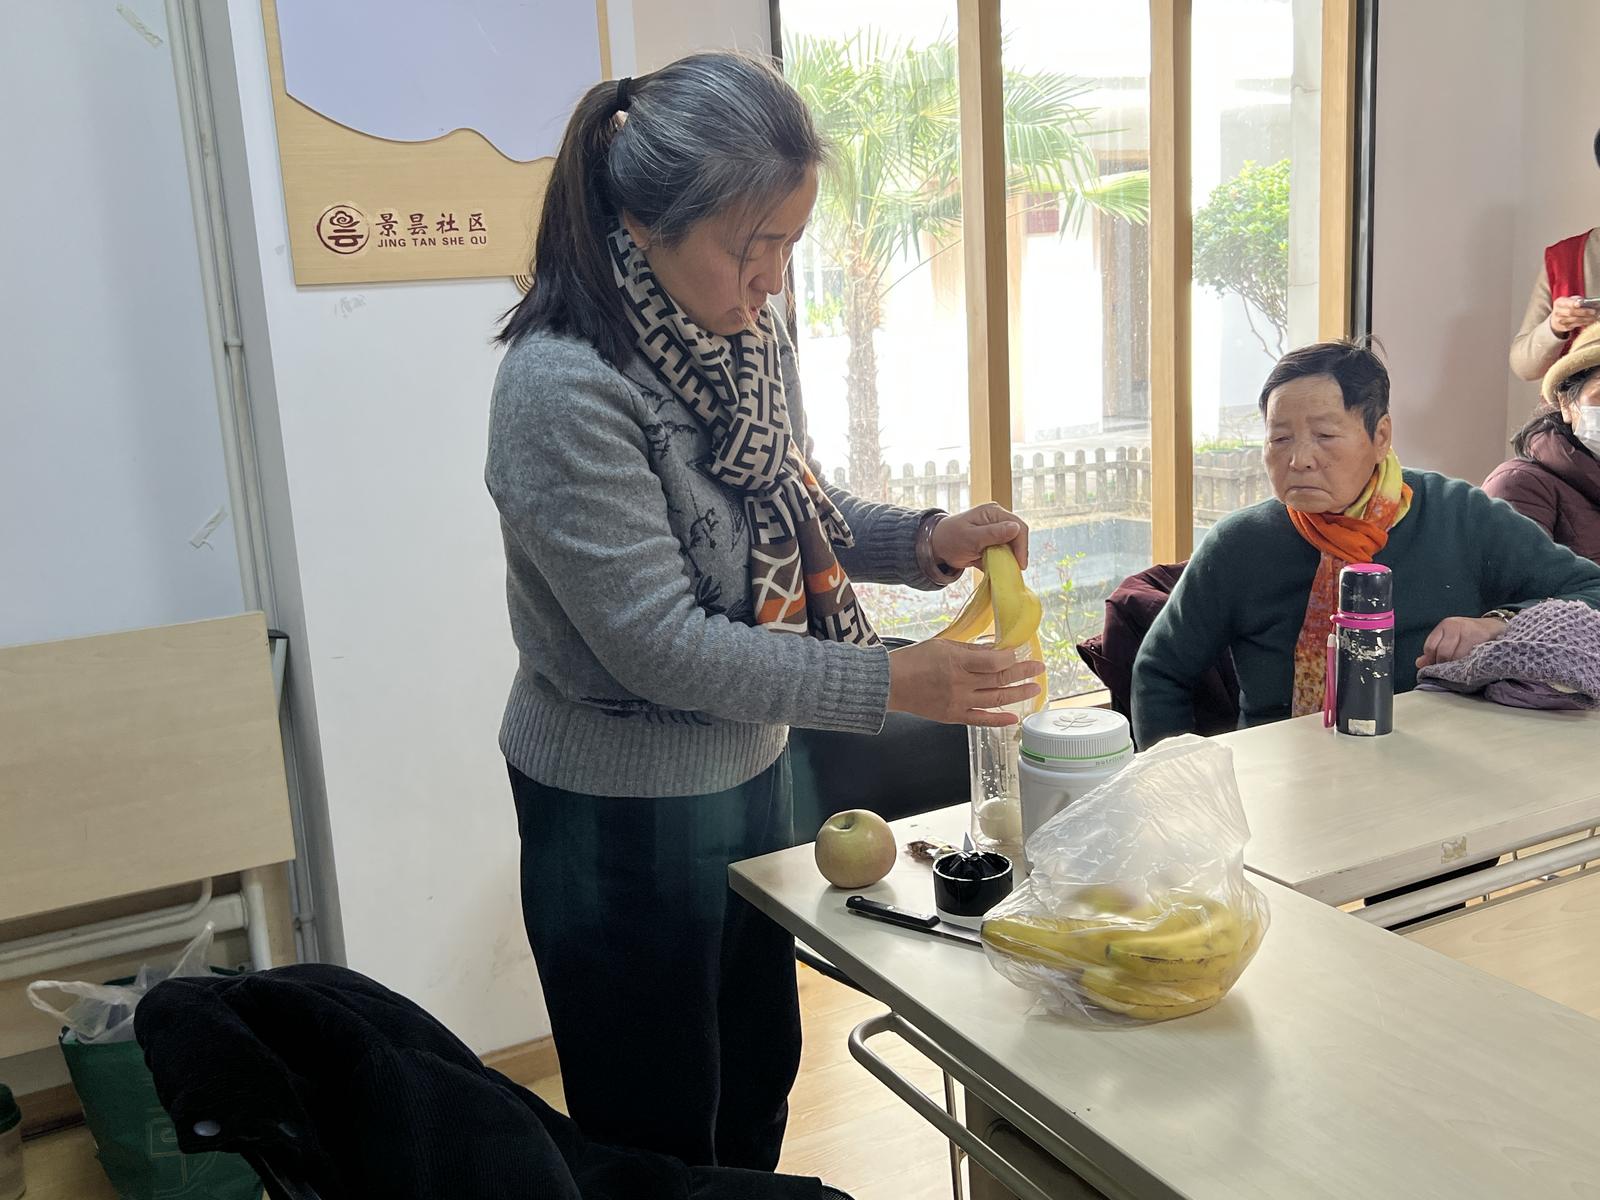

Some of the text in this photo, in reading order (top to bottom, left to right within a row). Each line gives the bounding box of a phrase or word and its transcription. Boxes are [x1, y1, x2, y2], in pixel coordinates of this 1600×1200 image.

[375, 212, 486, 237] 景昙社区
[377, 235, 487, 248] JING TAN SHE QU
